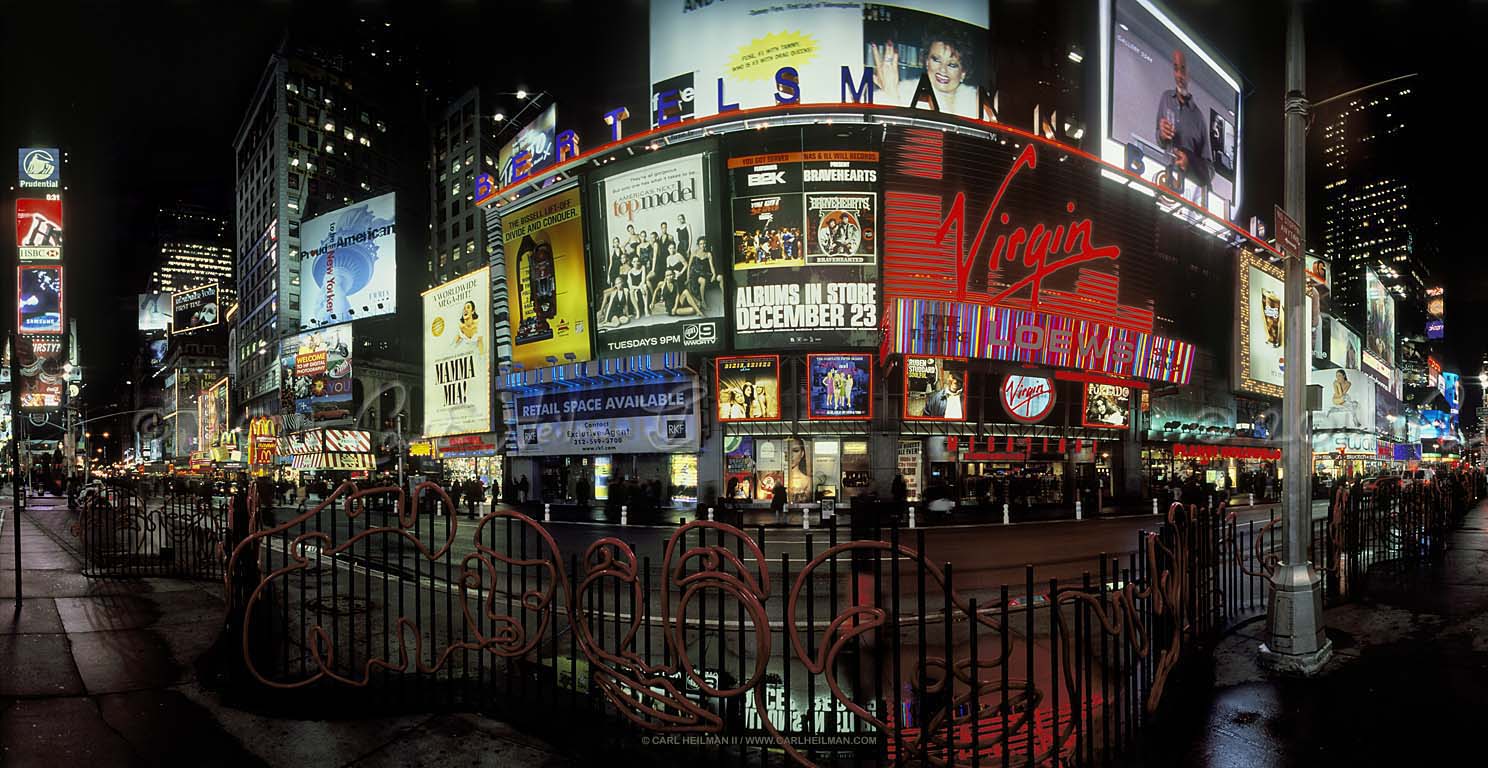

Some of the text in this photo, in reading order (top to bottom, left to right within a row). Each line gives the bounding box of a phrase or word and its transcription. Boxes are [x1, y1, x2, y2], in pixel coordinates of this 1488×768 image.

[804, 152, 817, 161] NAS
[824, 152, 833, 160] ILL
[834, 152, 849, 160] WILL
[803, 169, 877, 183] BRAVEHEARTS
[20, 180, 59, 188] Prudential
[613, 177, 697, 221] top model
[809, 196, 871, 211] BRAVEHEARTS
[520, 212, 542, 226] BISSELL
[336, 223, 396, 248] American
[505, 227, 526, 241] DIVIDE
[527, 220, 542, 233] AND
[936, 144, 1121, 314] Virgin
[20, 249, 46, 257] HSBC
[326, 250, 335, 275] New
[326, 277, 336, 313] Yorker
[737, 283, 876, 308] ALBUMS IN STORE
[736, 304, 877, 330] DECEMBER 23
[608, 335, 681, 350] TUESDAYS 9PM
[988, 320, 1134, 363] LOEWS
[297, 353, 326, 364] WELCOME
[297, 366, 326, 375] PHOTOGRAPHY
[434, 355, 476, 386] MAMMA
[908, 365, 935, 375] STUDDARD
[328, 381, 351, 393] YOU
[443, 380, 467, 407] MIA!
[1006, 375, 1052, 417] Virgin
[522, 392, 685, 417] RETAIL SPACE AVAILABLE
[604, 428, 631, 438] Agent
[667, 421, 686, 434] RKF
[523, 430, 537, 442] RKF
